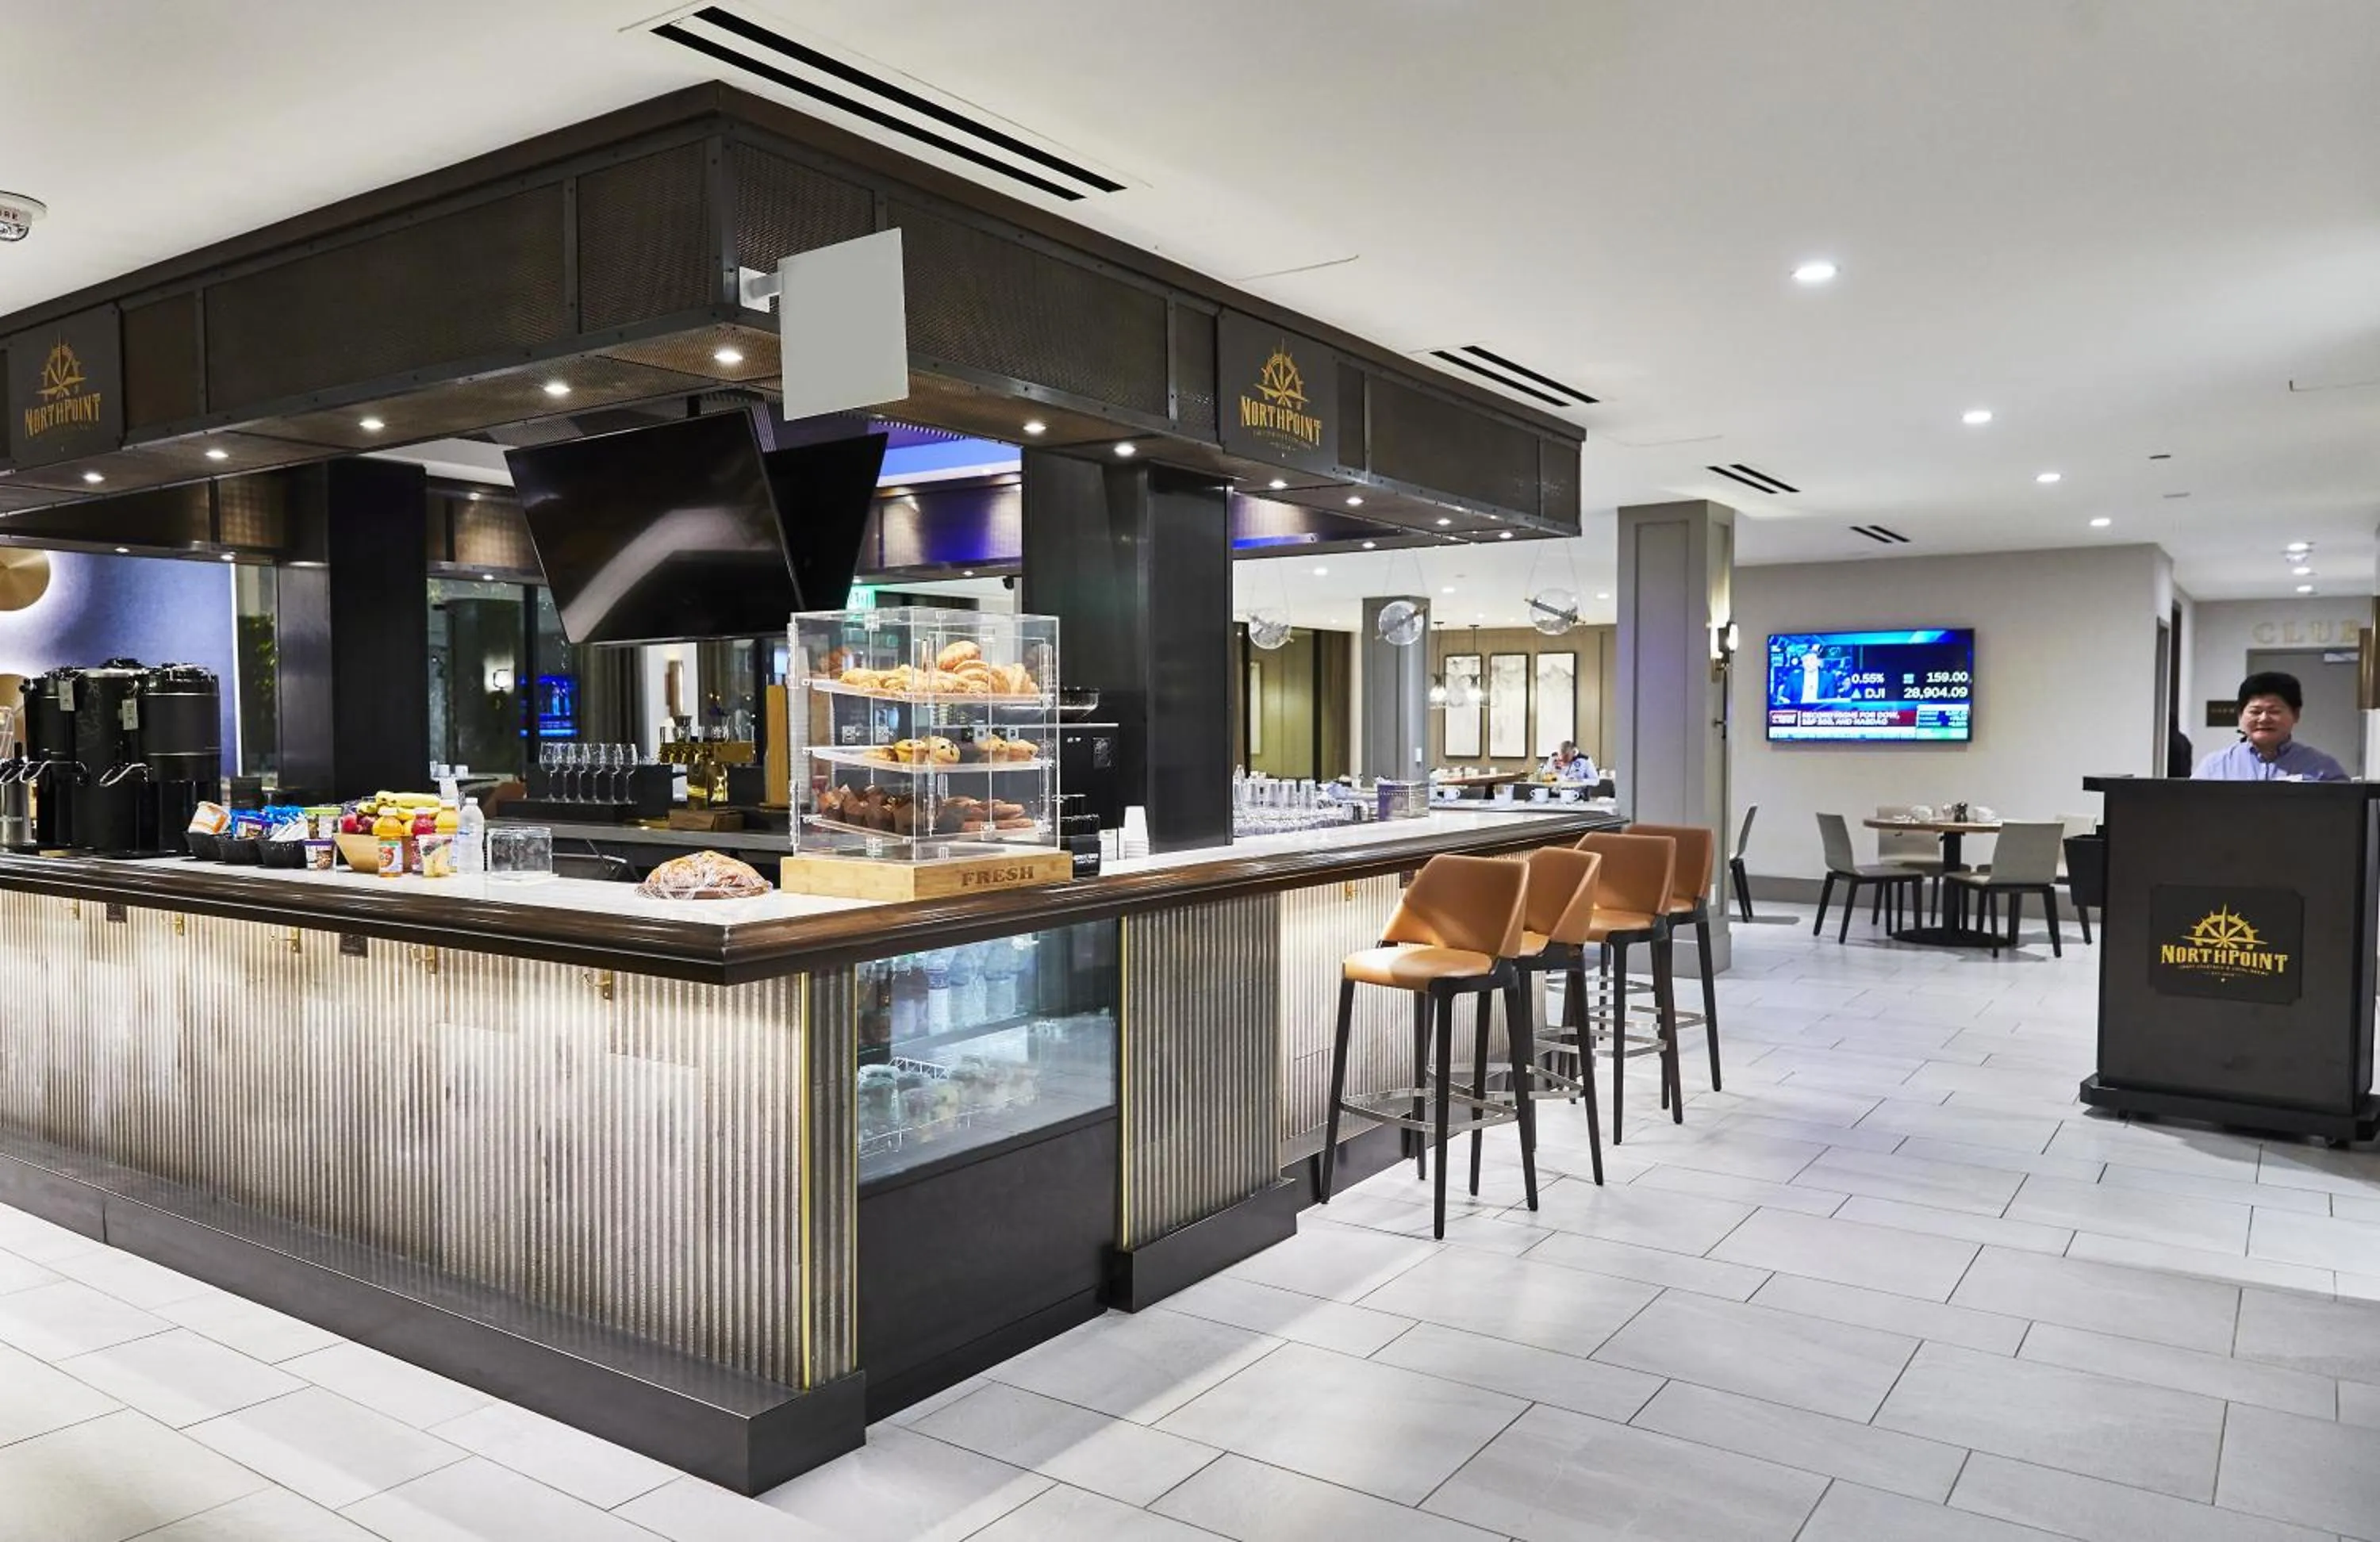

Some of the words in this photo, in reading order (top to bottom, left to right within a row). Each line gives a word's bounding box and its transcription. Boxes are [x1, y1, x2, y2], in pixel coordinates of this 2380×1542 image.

[25, 393, 102, 439] NORTHPOINT
[1240, 395, 1322, 447] NORTHPOINT
[1864, 688, 1886, 699] DJI
[962, 865, 1035, 887] FRESH
[2160, 944, 2289, 973] NORTHPOINT
